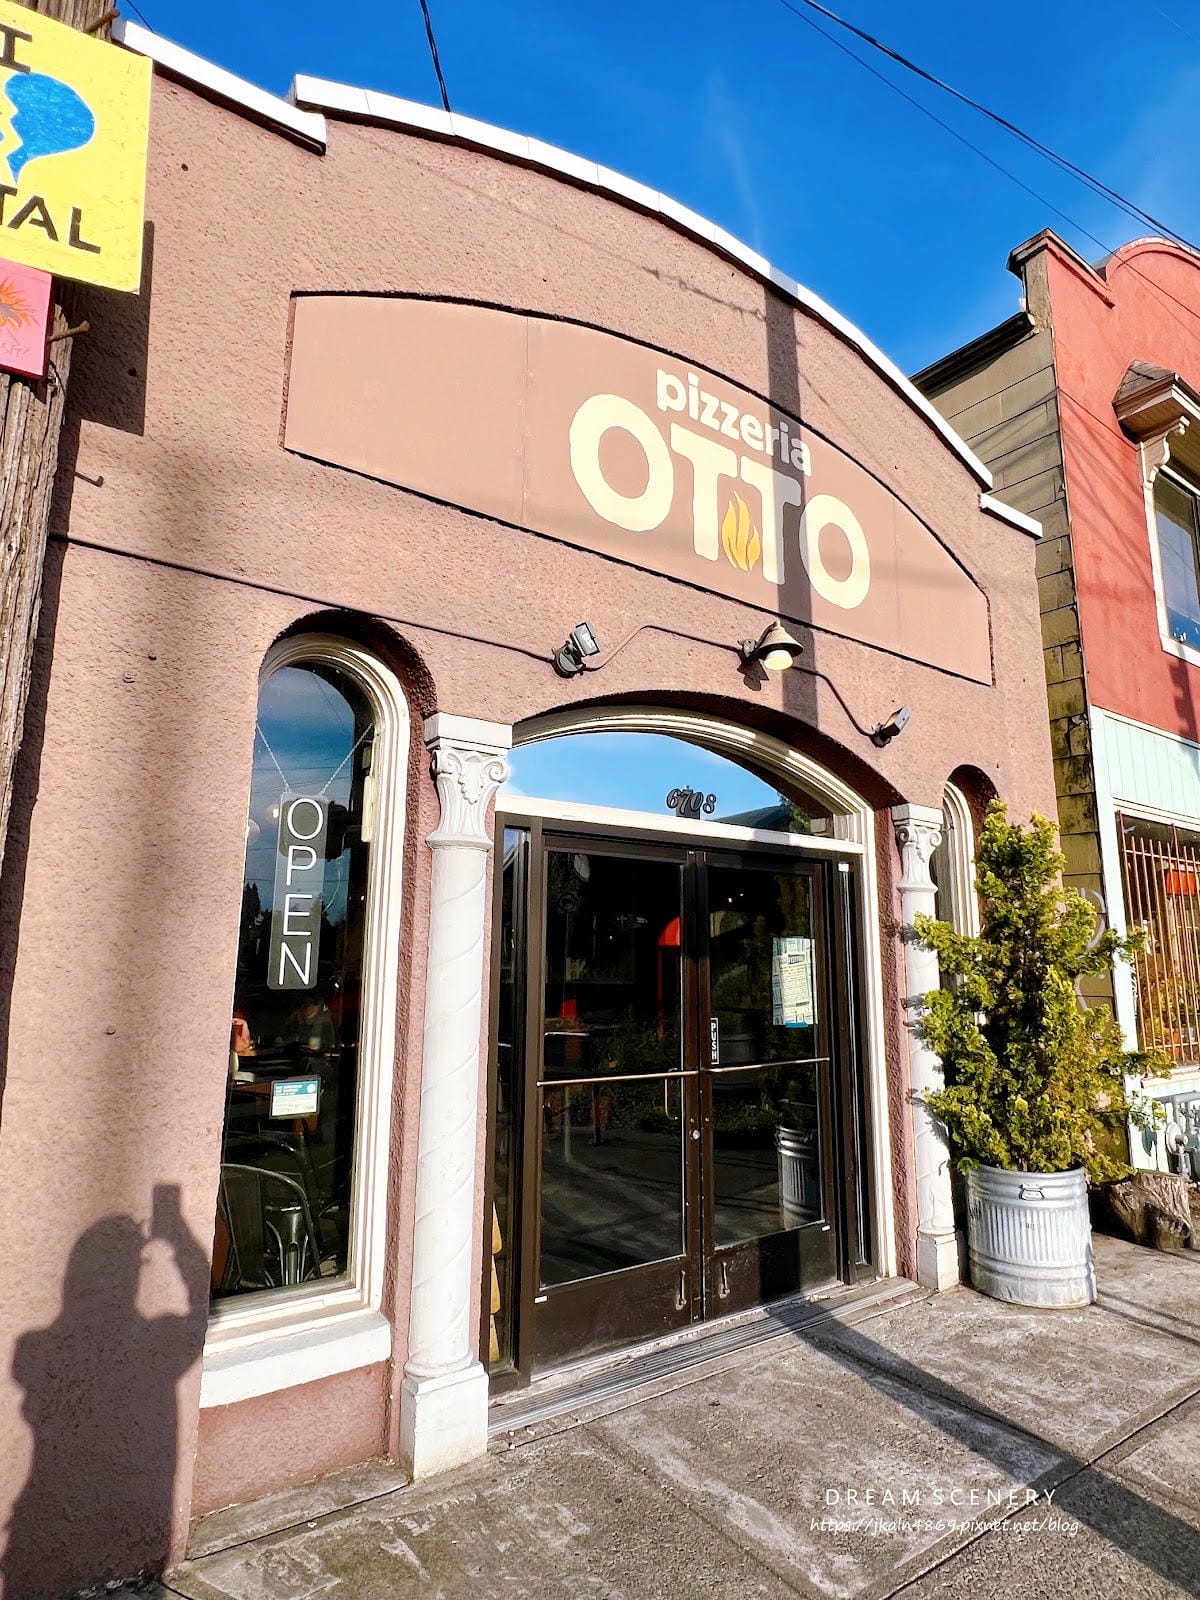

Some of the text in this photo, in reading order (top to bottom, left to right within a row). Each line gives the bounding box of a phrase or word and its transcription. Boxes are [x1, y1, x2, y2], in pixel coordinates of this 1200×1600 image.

[656, 368, 812, 478] pizzeria
[568, 393, 871, 610] OTTO
[666, 787, 717, 815] 6708
[277, 798, 324, 986] OPEN
[710, 1021, 718, 1061] PUSH
